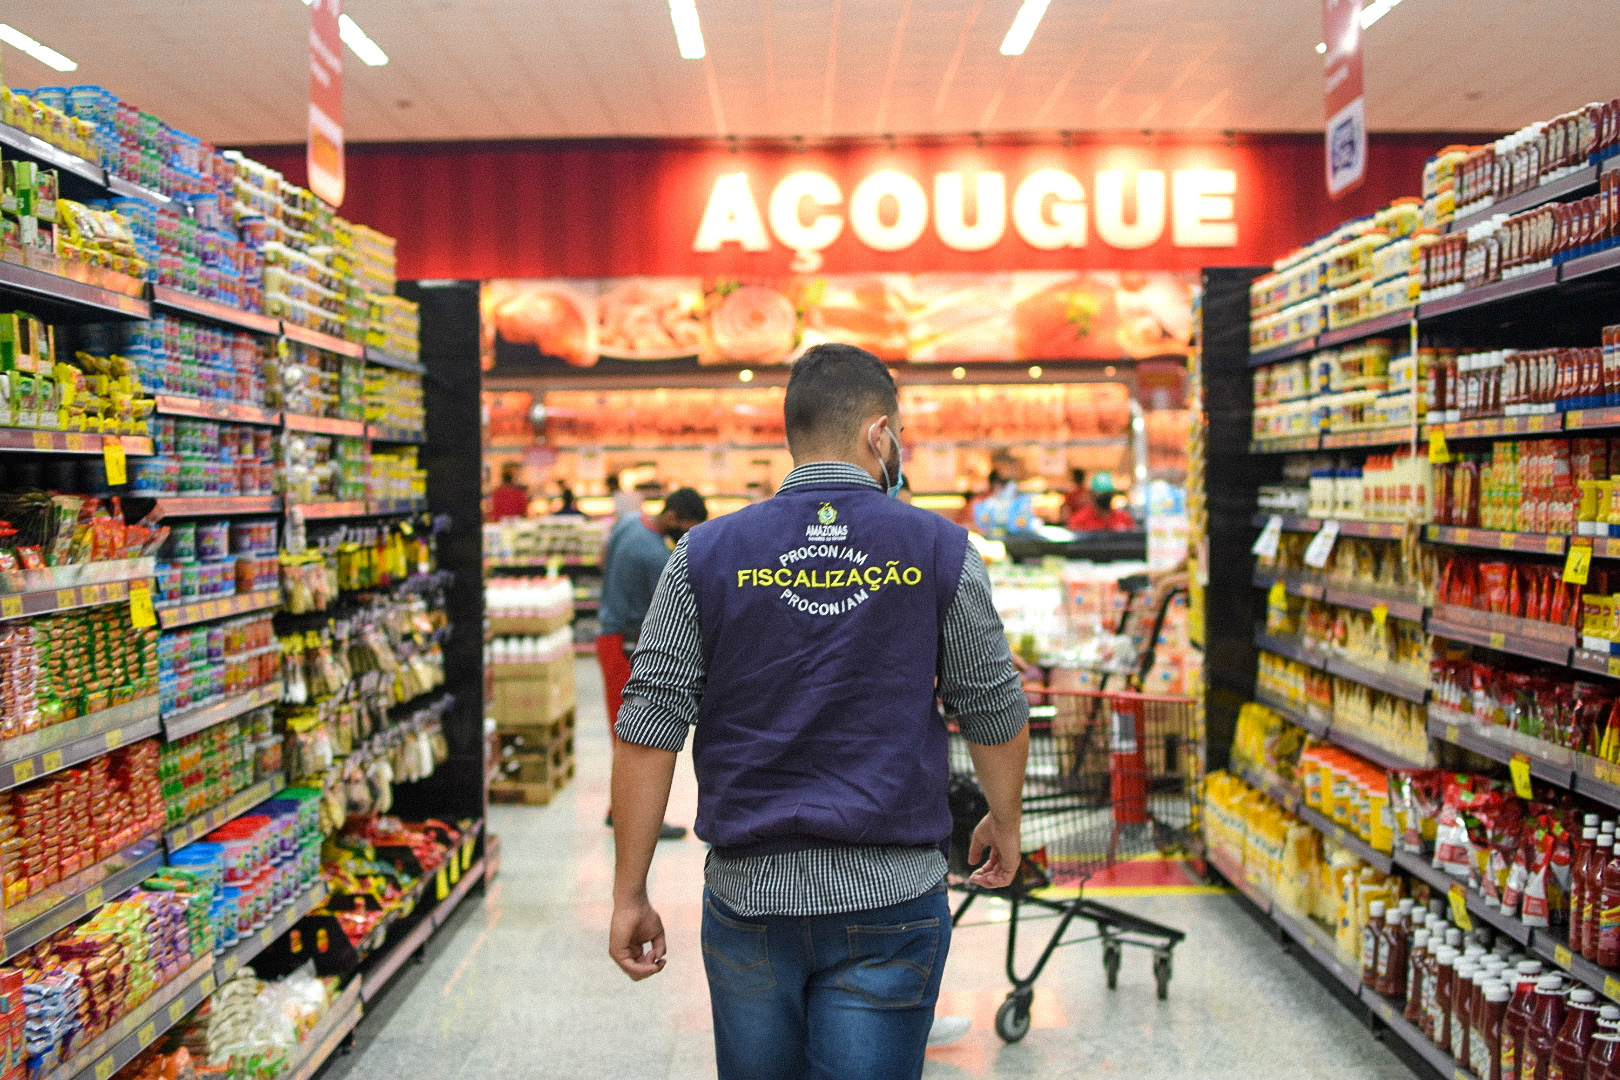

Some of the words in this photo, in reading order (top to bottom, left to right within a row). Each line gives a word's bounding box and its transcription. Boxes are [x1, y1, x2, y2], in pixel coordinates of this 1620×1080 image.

[693, 169, 1238, 272] AÇOUGUE
[805, 524, 848, 537] AMAZONAS
[778, 544, 869, 567] PROCON/AM
[737, 560, 922, 591] FISCALIZAÇÃO
[780, 588, 869, 616] PROCON/AM
